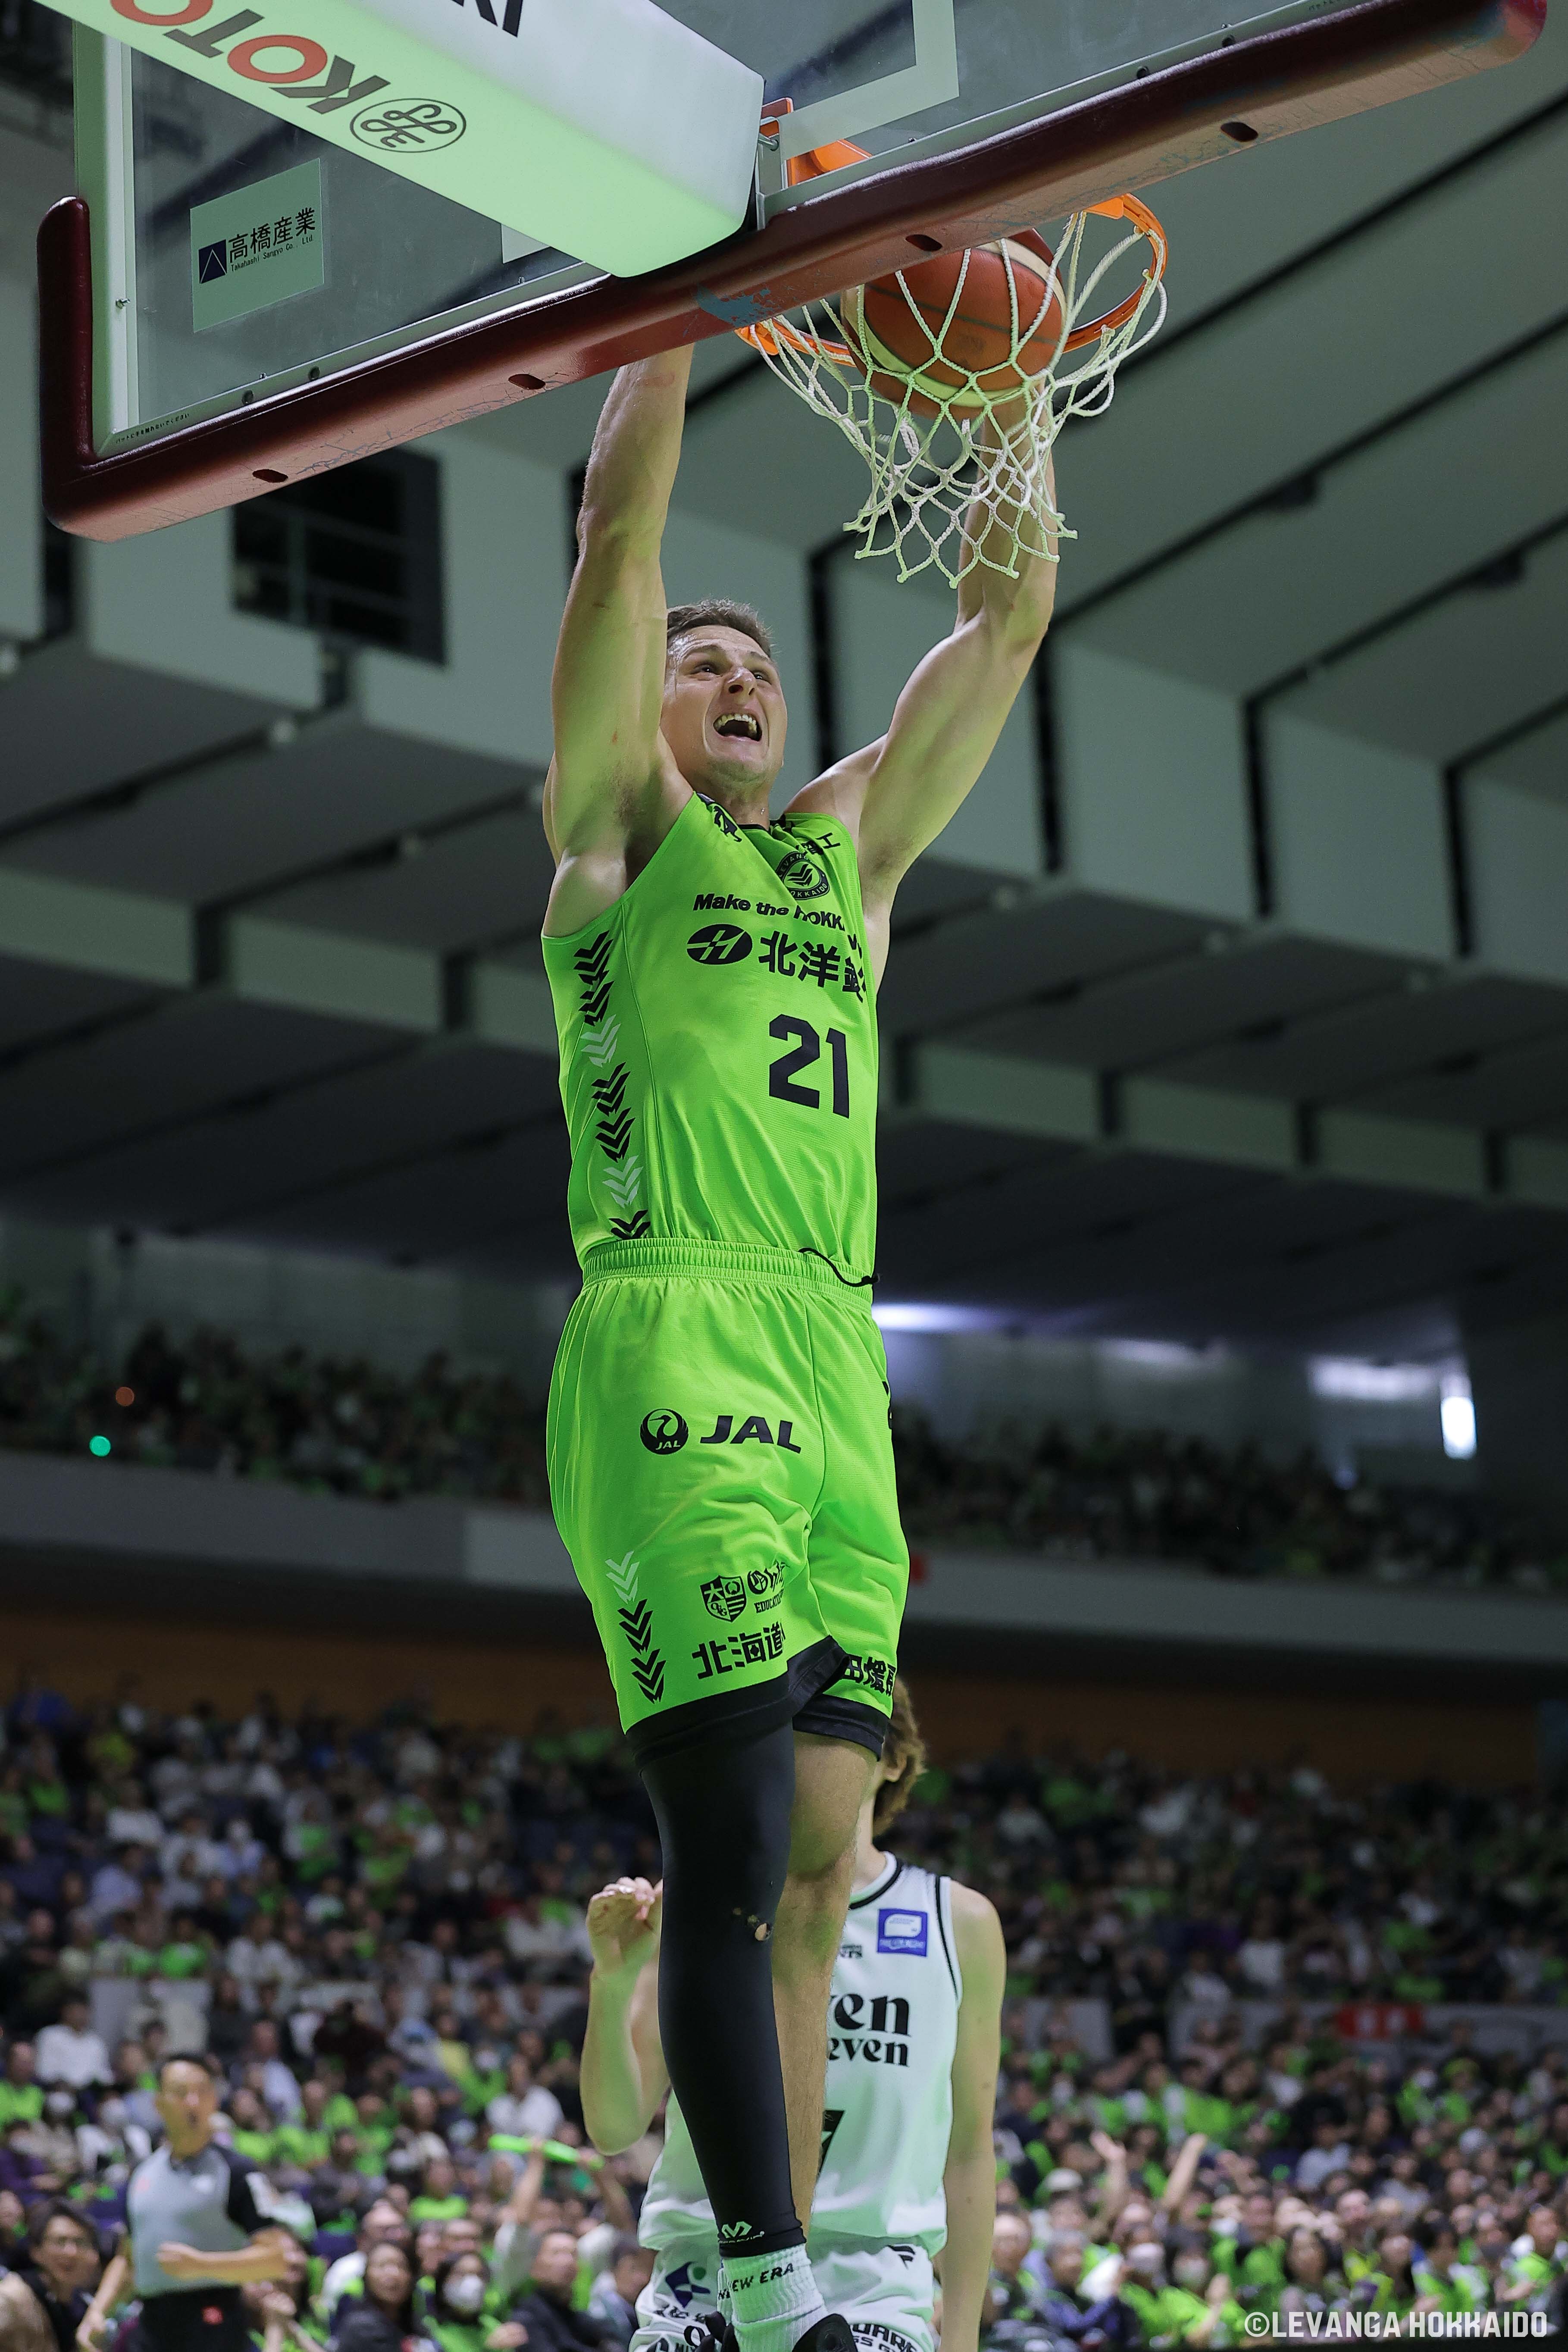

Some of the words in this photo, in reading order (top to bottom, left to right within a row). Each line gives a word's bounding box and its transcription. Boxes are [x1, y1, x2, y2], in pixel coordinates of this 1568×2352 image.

[228, 207, 315, 263] 高橋産業
[231, 255, 259, 272] Takahashi
[263, 248, 283, 260] Sangyo
[791, 883, 827, 897] OKKAIDO
[693, 893, 751, 911] Make
[756, 902, 789, 916] the
[769, 1014, 849, 1119] 21
[656, 1440, 681, 1450] JAL
[700, 1415, 801, 1453] JAL
[760, 2263, 794, 2283] ERA
